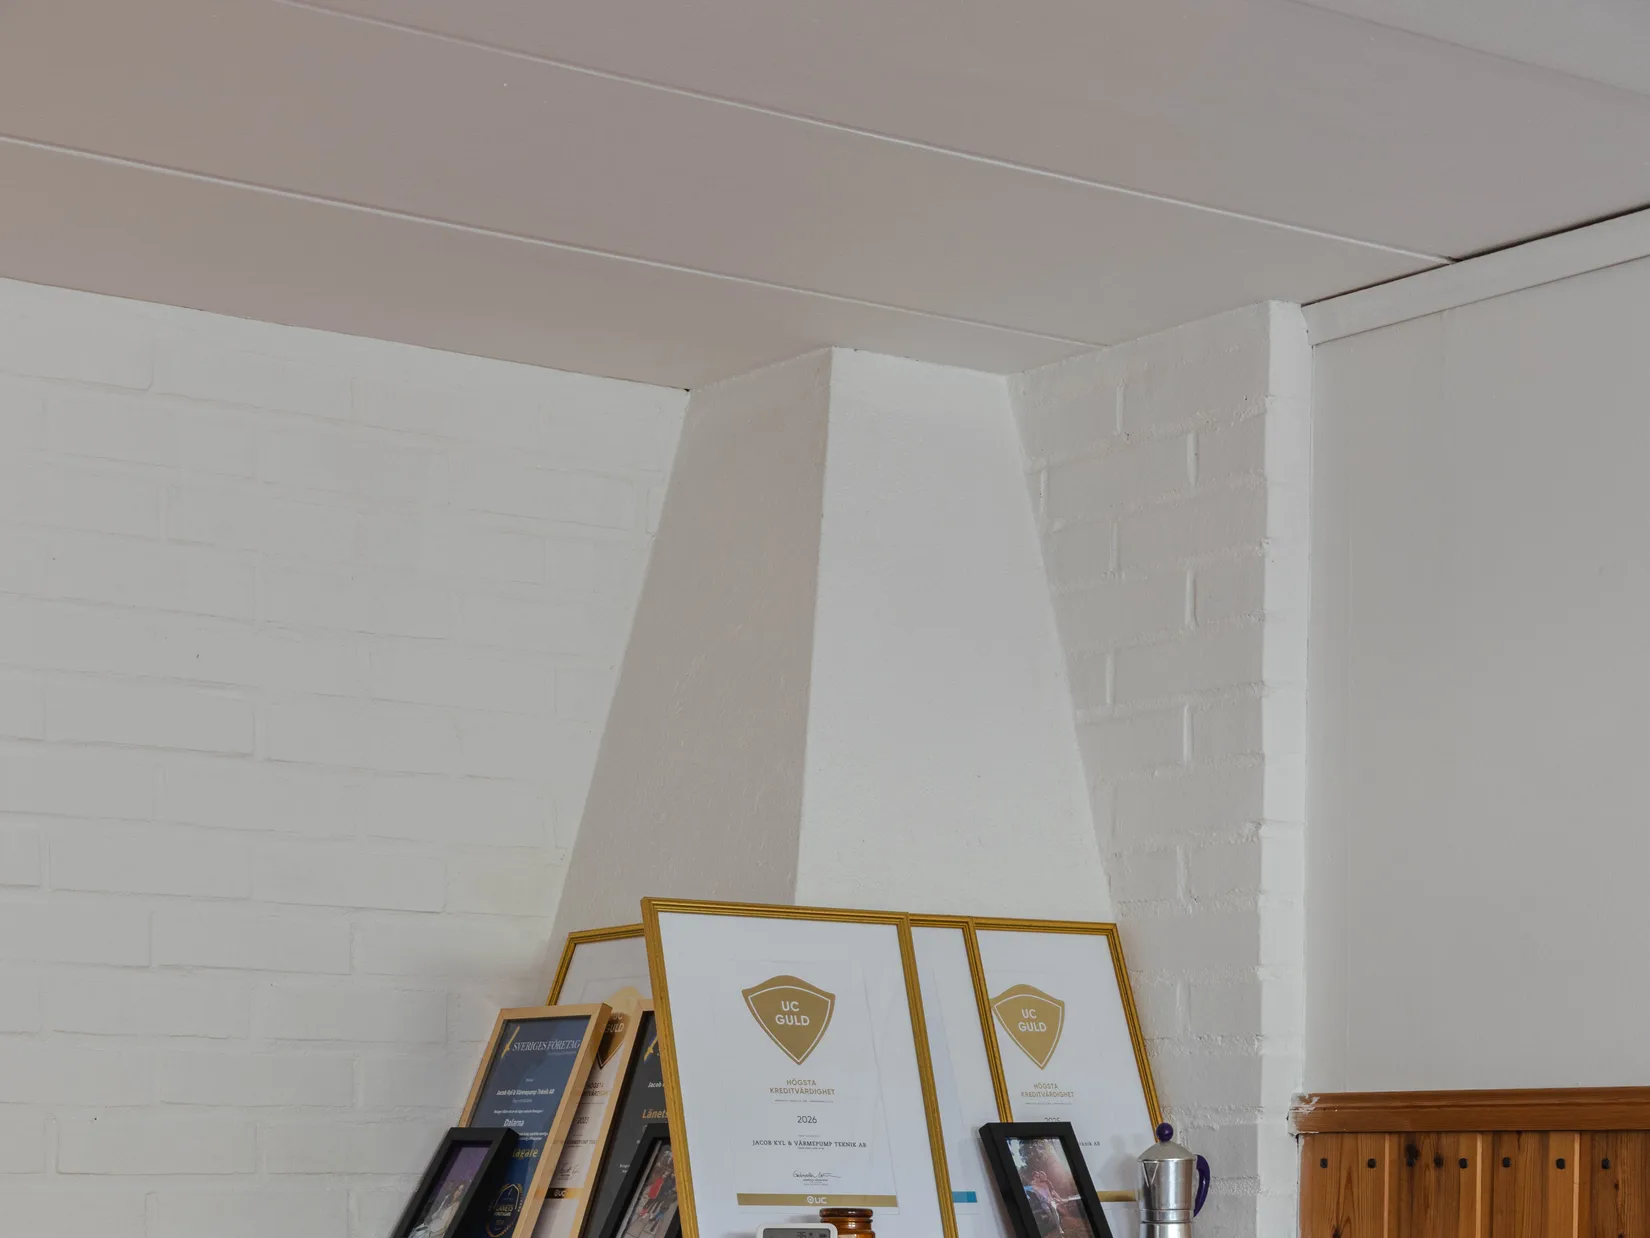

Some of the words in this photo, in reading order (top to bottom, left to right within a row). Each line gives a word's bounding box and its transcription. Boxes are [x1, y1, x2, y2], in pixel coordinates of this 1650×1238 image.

[781, 1001, 800, 1011] UC
[1021, 1008, 1037, 1019] UC
[775, 1014, 810, 1025] GULD
[1018, 1022, 1047, 1032] GULD
[512, 1041, 547, 1051] SVERIGES
[547, 1039, 581, 1050] FÖRETAG
[786, 1078, 817, 1086] HÖGSTA
[1033, 1082, 1058, 1090] HÖGSTA
[769, 1087, 835, 1096] KREDITVÄRDIGHET
[797, 1115, 818, 1124] 2026
[794, 1139, 832, 1147] VÄRMEPUMP
